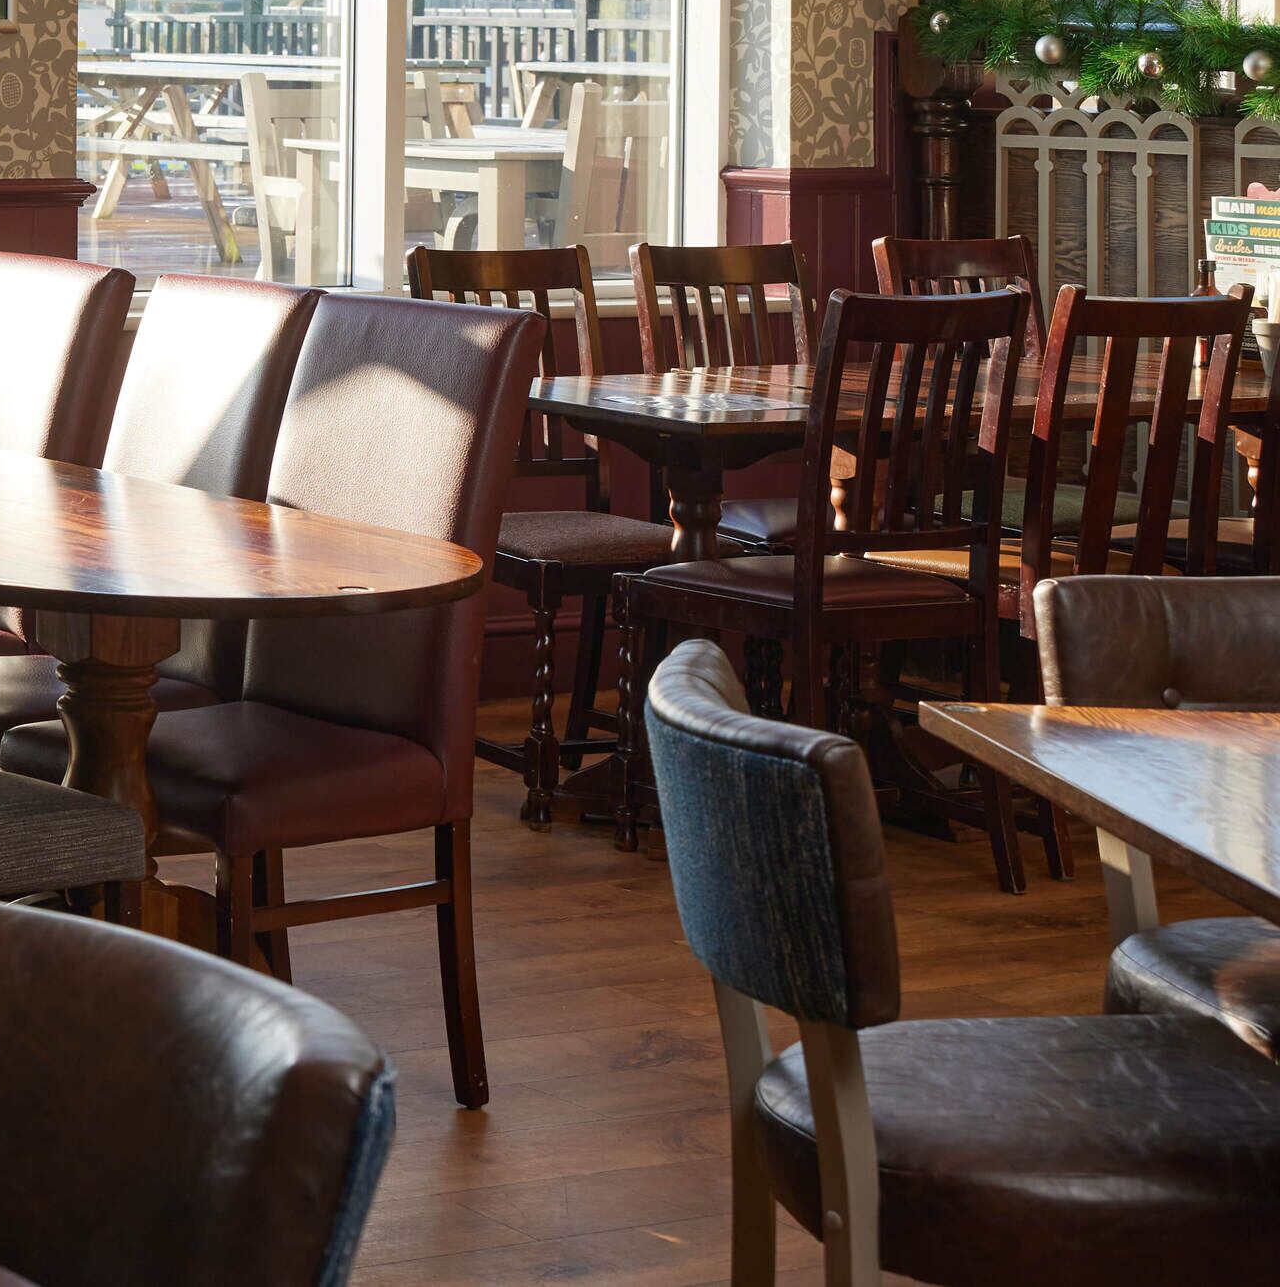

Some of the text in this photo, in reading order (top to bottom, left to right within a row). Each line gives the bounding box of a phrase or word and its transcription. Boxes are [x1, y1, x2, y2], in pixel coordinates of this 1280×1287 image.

[1218, 202, 1255, 214] MAIN
[1210, 222, 1249, 236] KIDS
[1215, 237, 1254, 254] drinks
